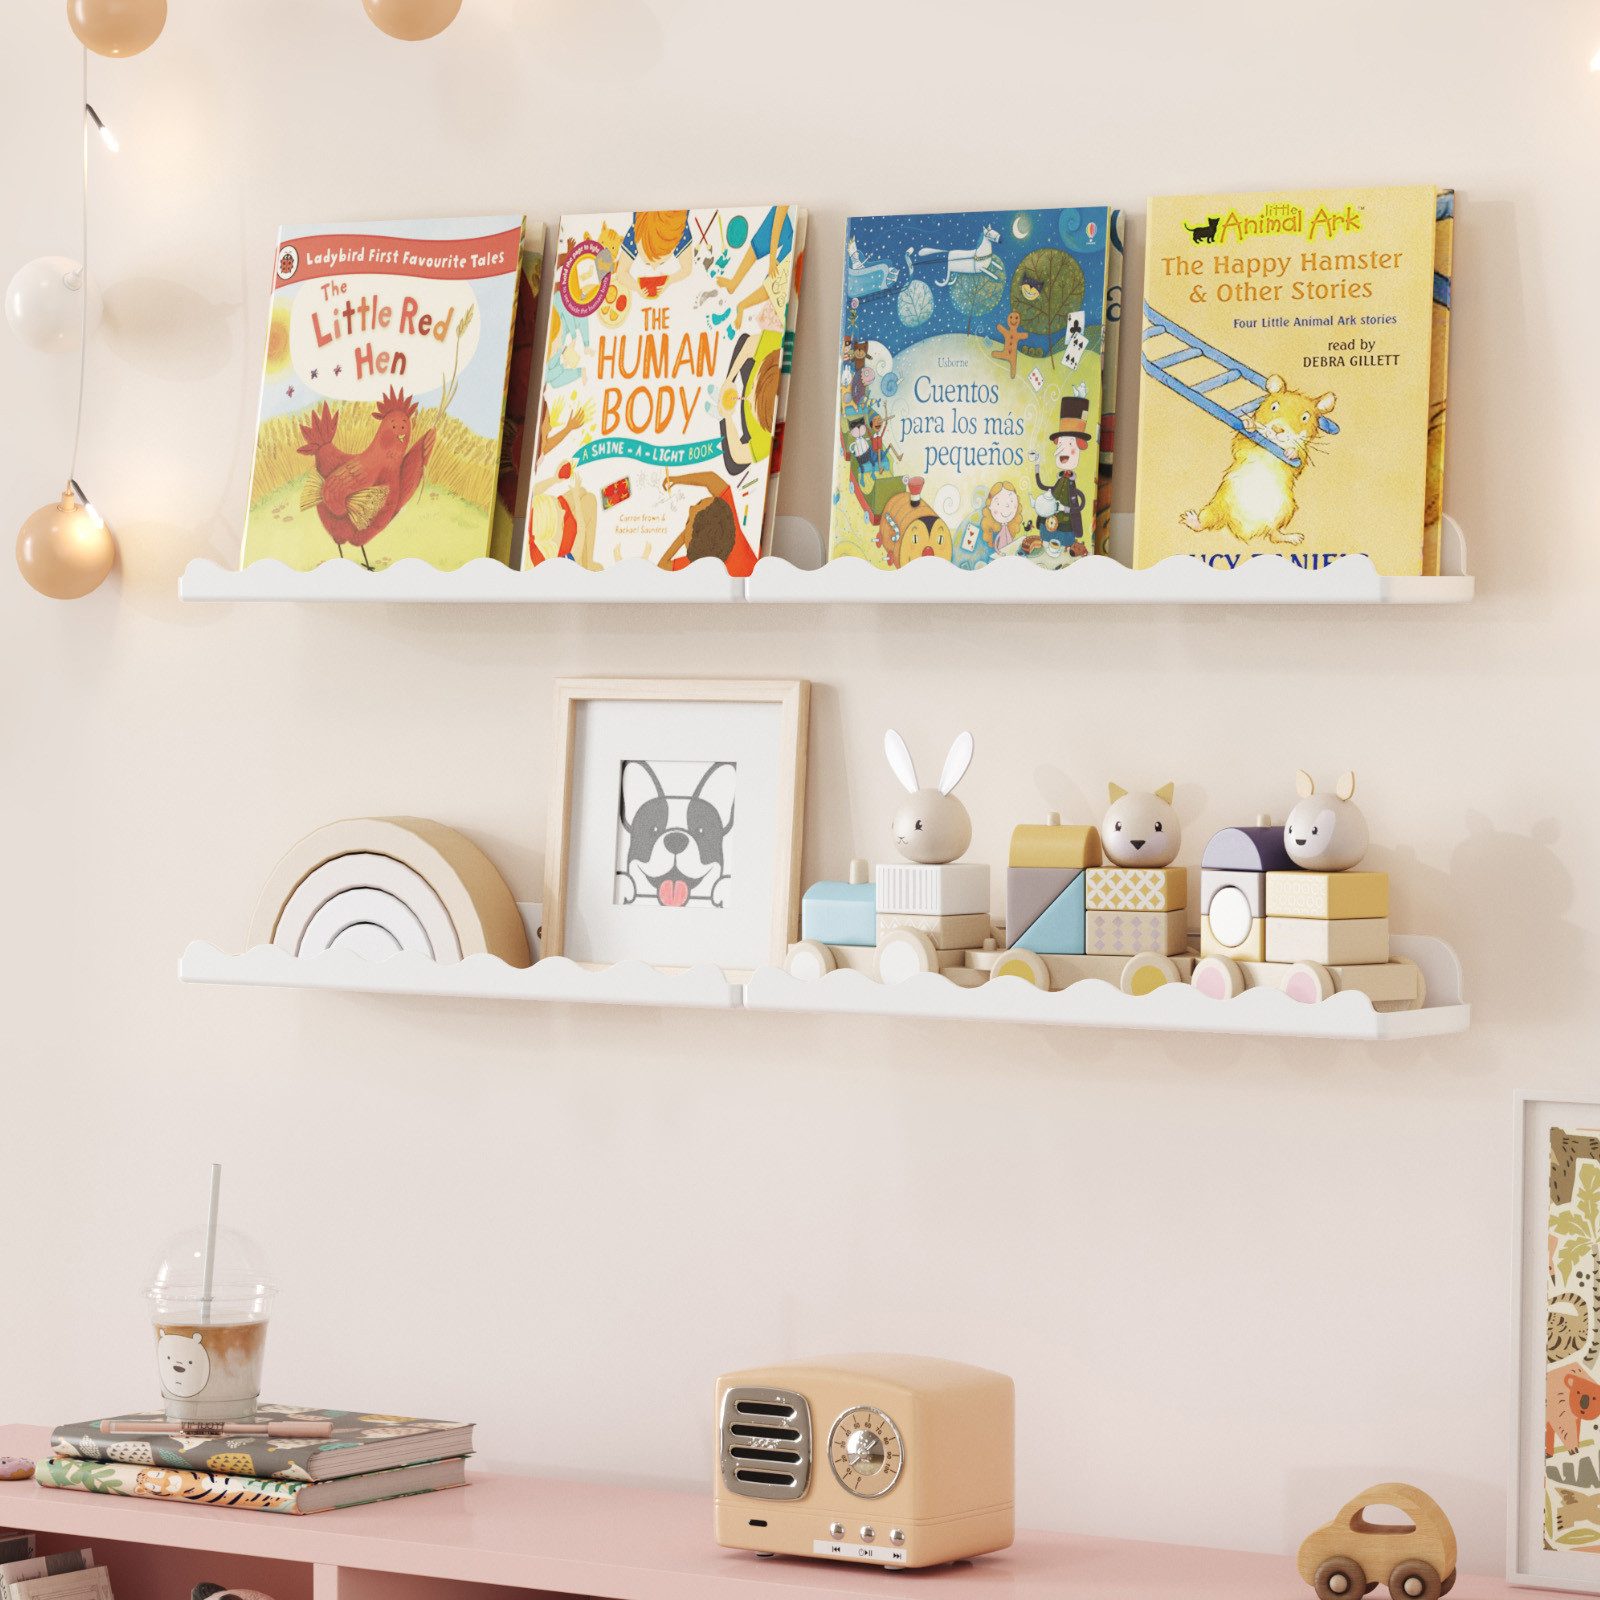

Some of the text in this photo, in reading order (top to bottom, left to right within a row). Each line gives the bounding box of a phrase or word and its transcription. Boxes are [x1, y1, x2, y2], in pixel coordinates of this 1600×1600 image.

[1265, 204, 1299, 216] little
[1220, 210, 1302, 243] Animal
[1309, 207, 1361, 240] Ark
[306, 247, 505, 268] Ladybird First Favourite Tales
[1160, 251, 1403, 278] The Happy Hamster
[321, 280, 348, 301] The
[1189, 279, 1373, 303] & Other Stories
[311, 294, 455, 348] Little Red
[642, 306, 670, 331] THE
[1233, 314, 1398, 329] Four Little Animal Ark stories
[597, 331, 720, 380] HUMAN
[1328, 339, 1376, 352] read by
[354, 342, 407, 381] Hen
[937, 356, 969, 370] Usborne
[1303, 354, 1400, 368] DEBRA GILLETT
[913, 375, 999, 405] Cuentos
[601, 385, 702, 436] BODY
[900, 408, 1024, 443] para los más
[582, 448, 588, 460] A
[688, 442, 714, 460] BOOK
[924, 441, 1024, 474] pequeños
